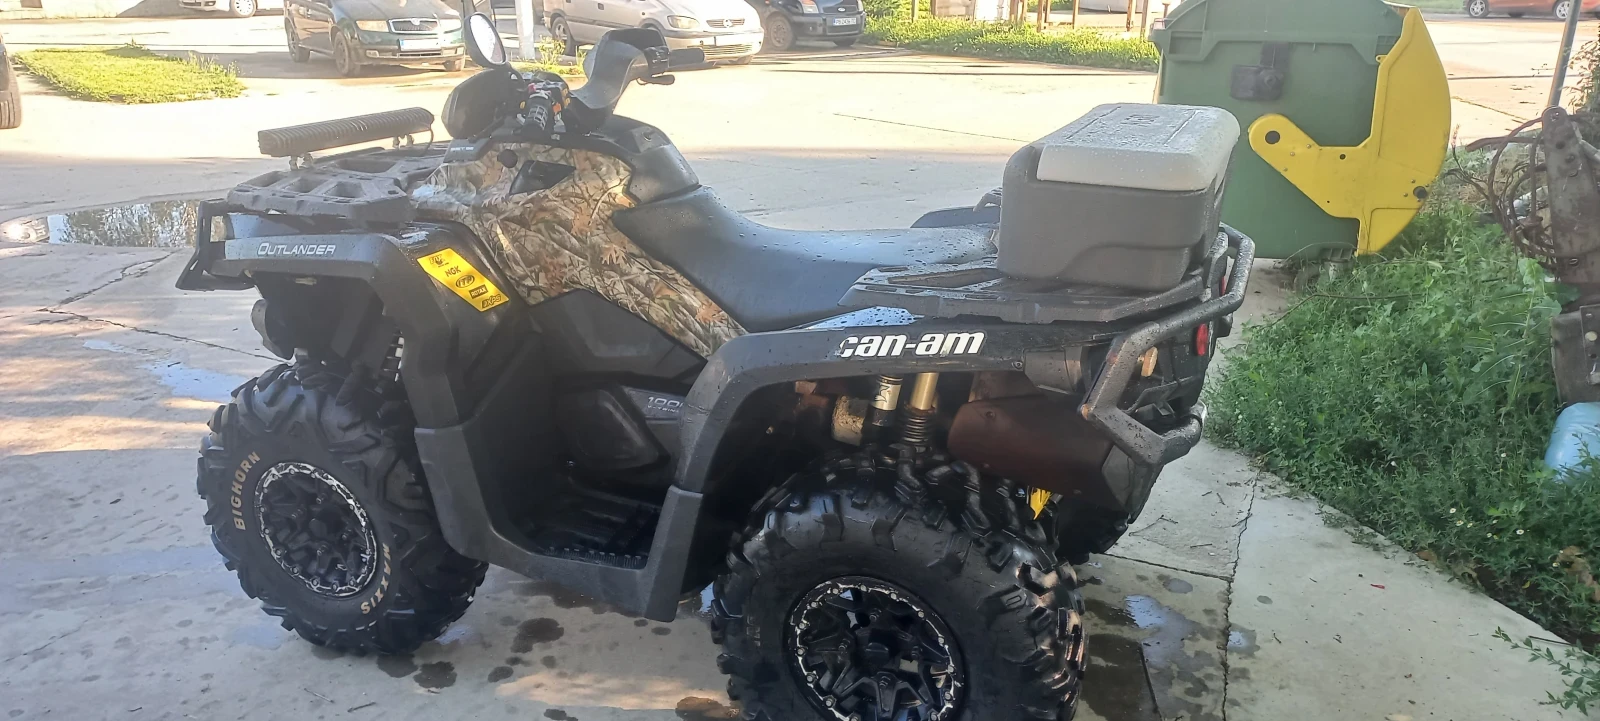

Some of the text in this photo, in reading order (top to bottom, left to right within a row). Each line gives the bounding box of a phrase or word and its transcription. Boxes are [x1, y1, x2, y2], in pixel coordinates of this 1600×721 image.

[258, 243, 336, 255] OUTLANDER
[445, 265, 461, 277] NGK
[470, 286, 487, 298] ROTAX
[839, 332, 985, 357] can-am
[648, 396, 684, 408] 100
[231, 451, 261, 531] BIGHORN
[360, 542, 392, 614] MAXXIS
